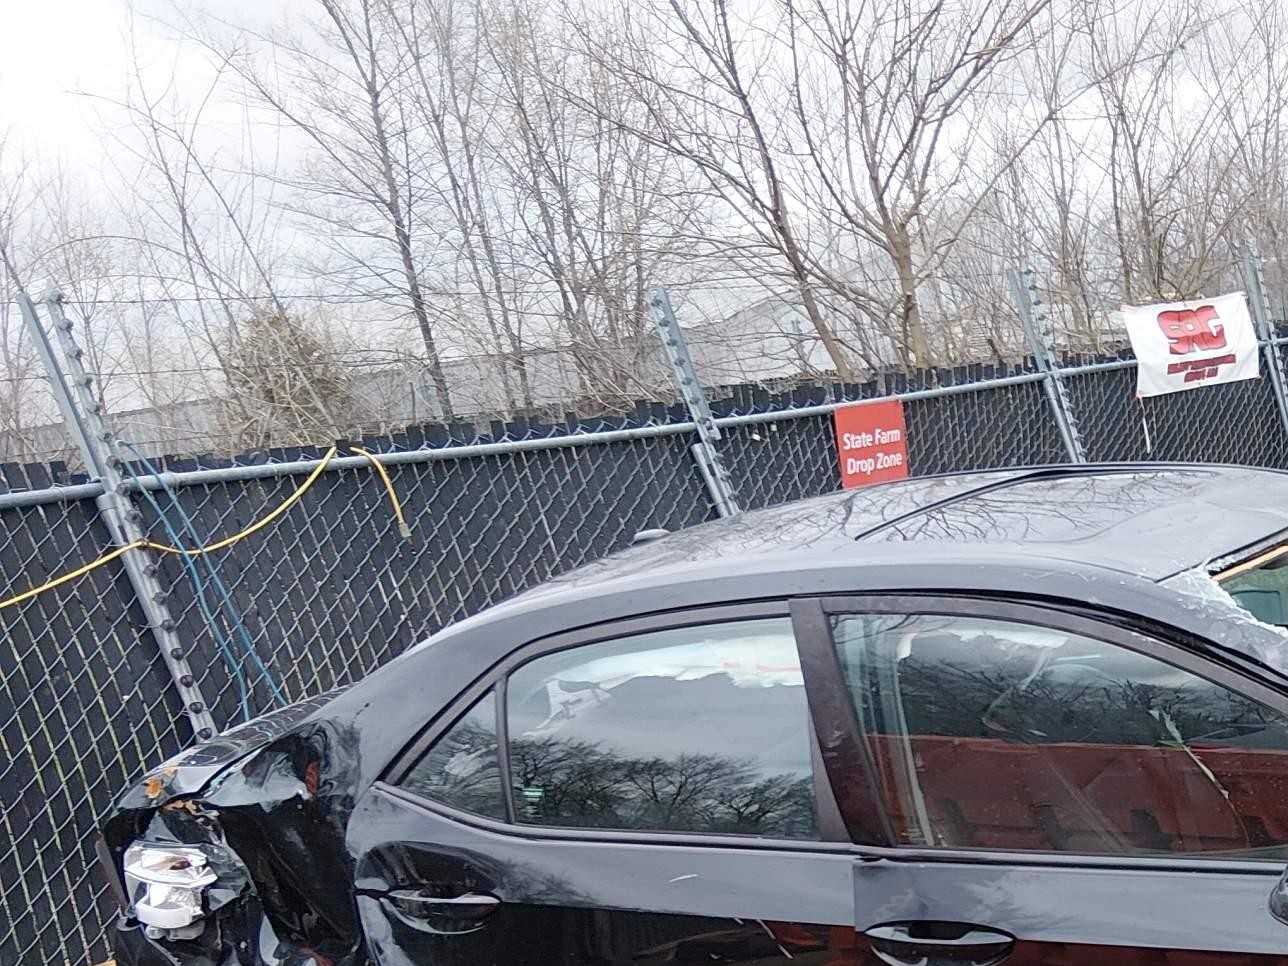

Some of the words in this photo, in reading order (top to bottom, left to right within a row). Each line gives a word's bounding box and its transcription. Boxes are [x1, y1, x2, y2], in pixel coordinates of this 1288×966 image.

[843, 432, 873, 450] State
[875, 429, 901, 445] Farm
[847, 458, 875, 475] Drop
[876, 453, 903, 469] Zone
